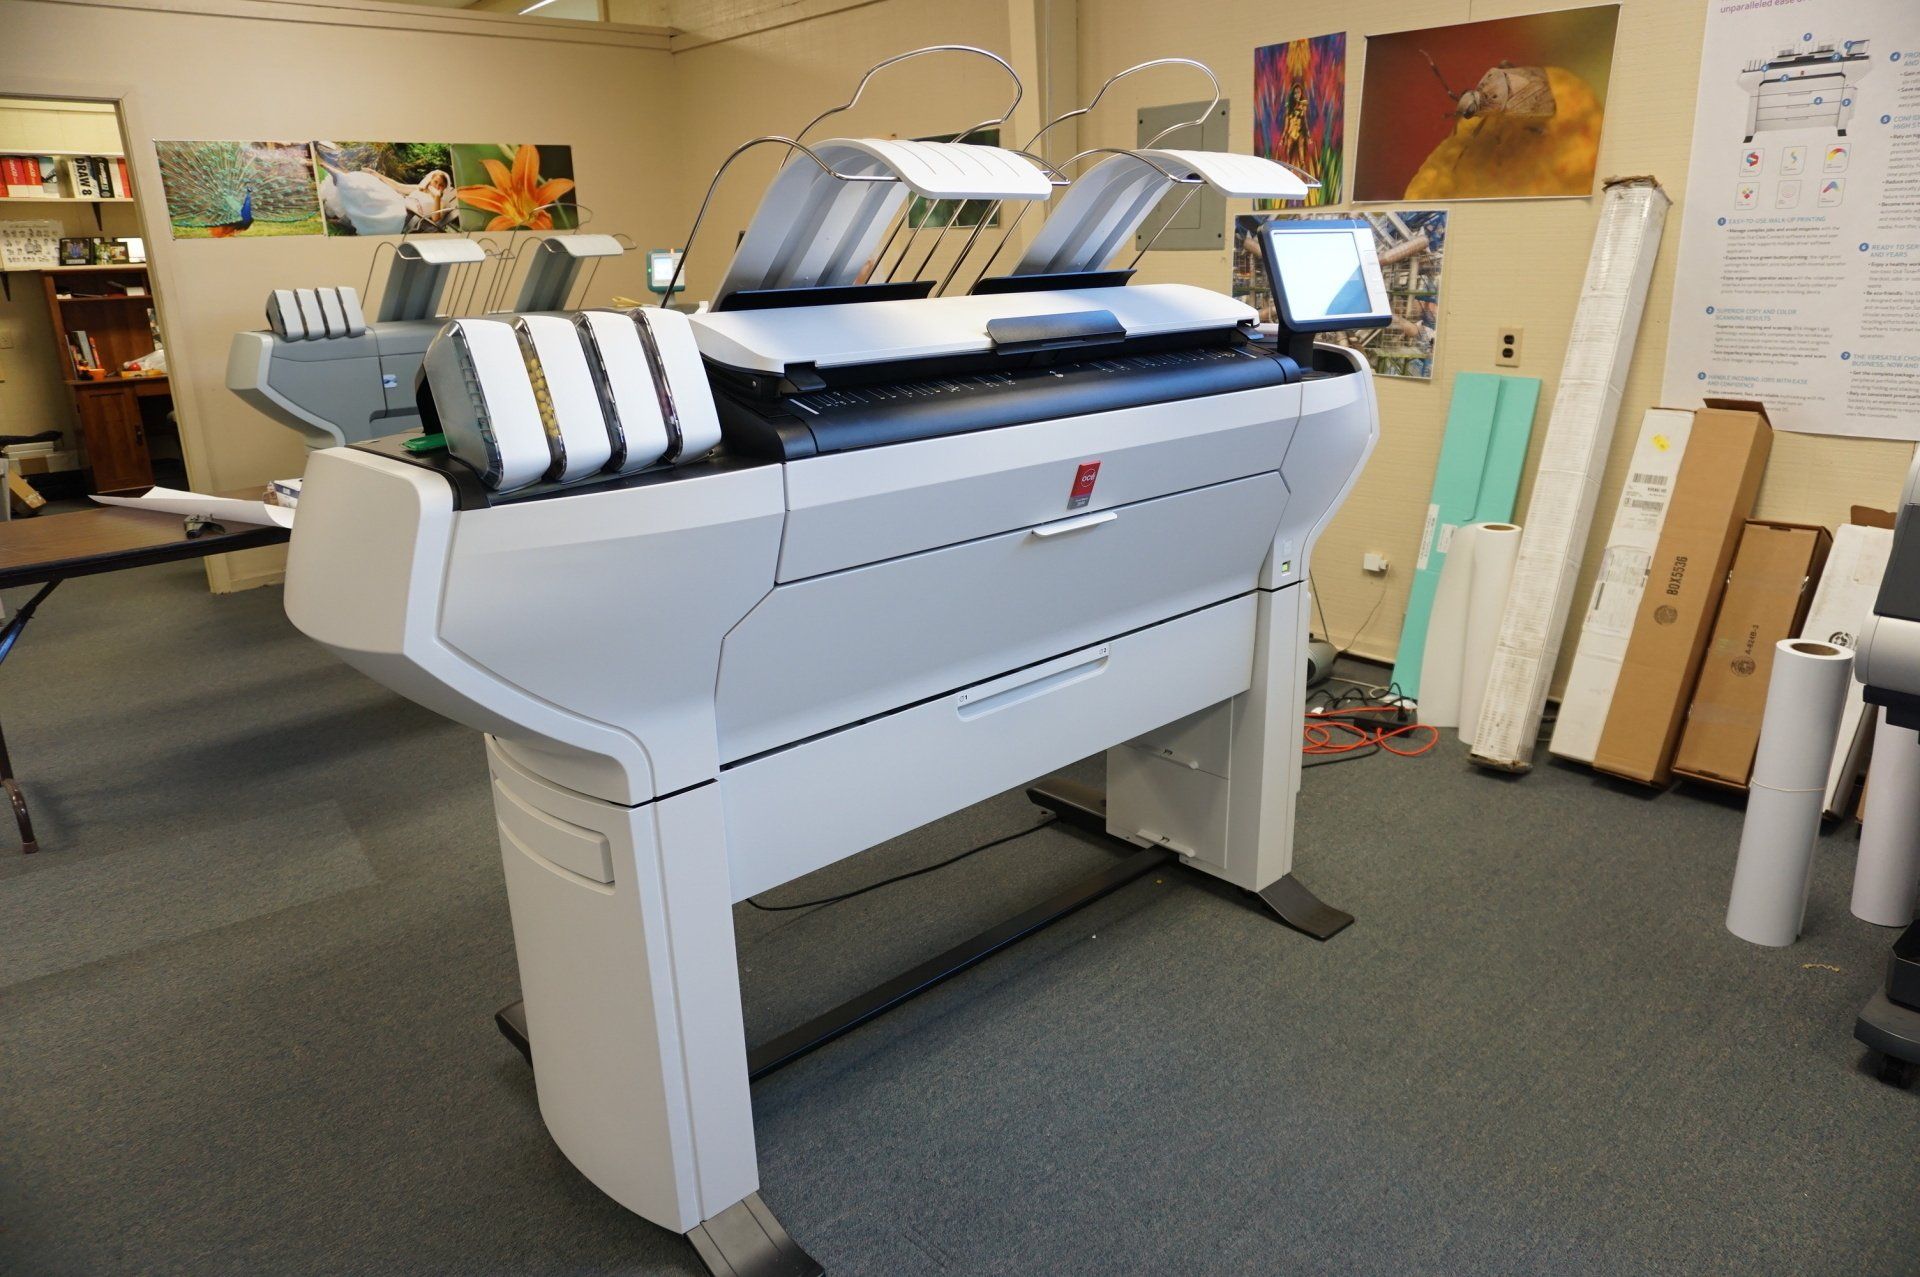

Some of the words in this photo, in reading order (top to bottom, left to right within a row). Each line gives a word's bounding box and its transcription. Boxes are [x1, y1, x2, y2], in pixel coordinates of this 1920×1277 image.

[1720, 0, 1773, 14] unparalleled
[75, 158, 91, 187] DRAW
[1666, 556, 1688, 596] BOX5536
